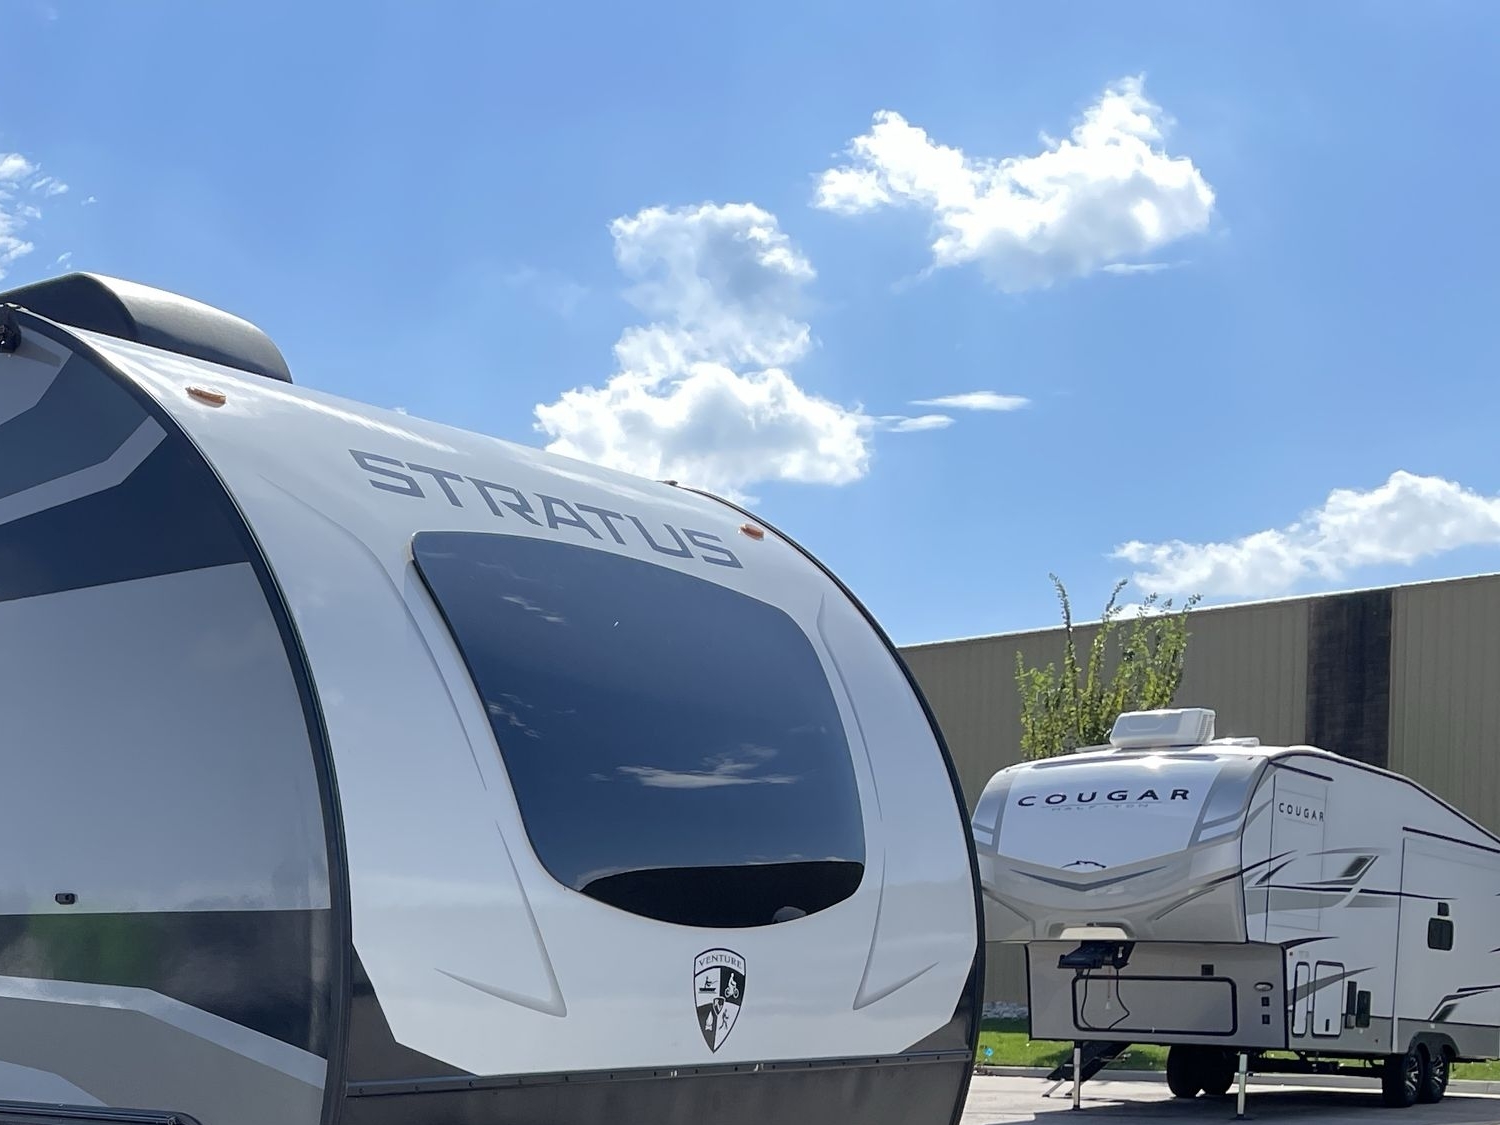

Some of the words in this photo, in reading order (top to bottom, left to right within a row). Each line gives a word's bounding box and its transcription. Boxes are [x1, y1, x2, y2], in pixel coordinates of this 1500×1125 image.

[349, 449, 743, 568] STRATUS
[1017, 788, 1190, 807] COUGAR
[1278, 802, 1324, 822] COUGAR
[698, 954, 743, 969] VENTURE
